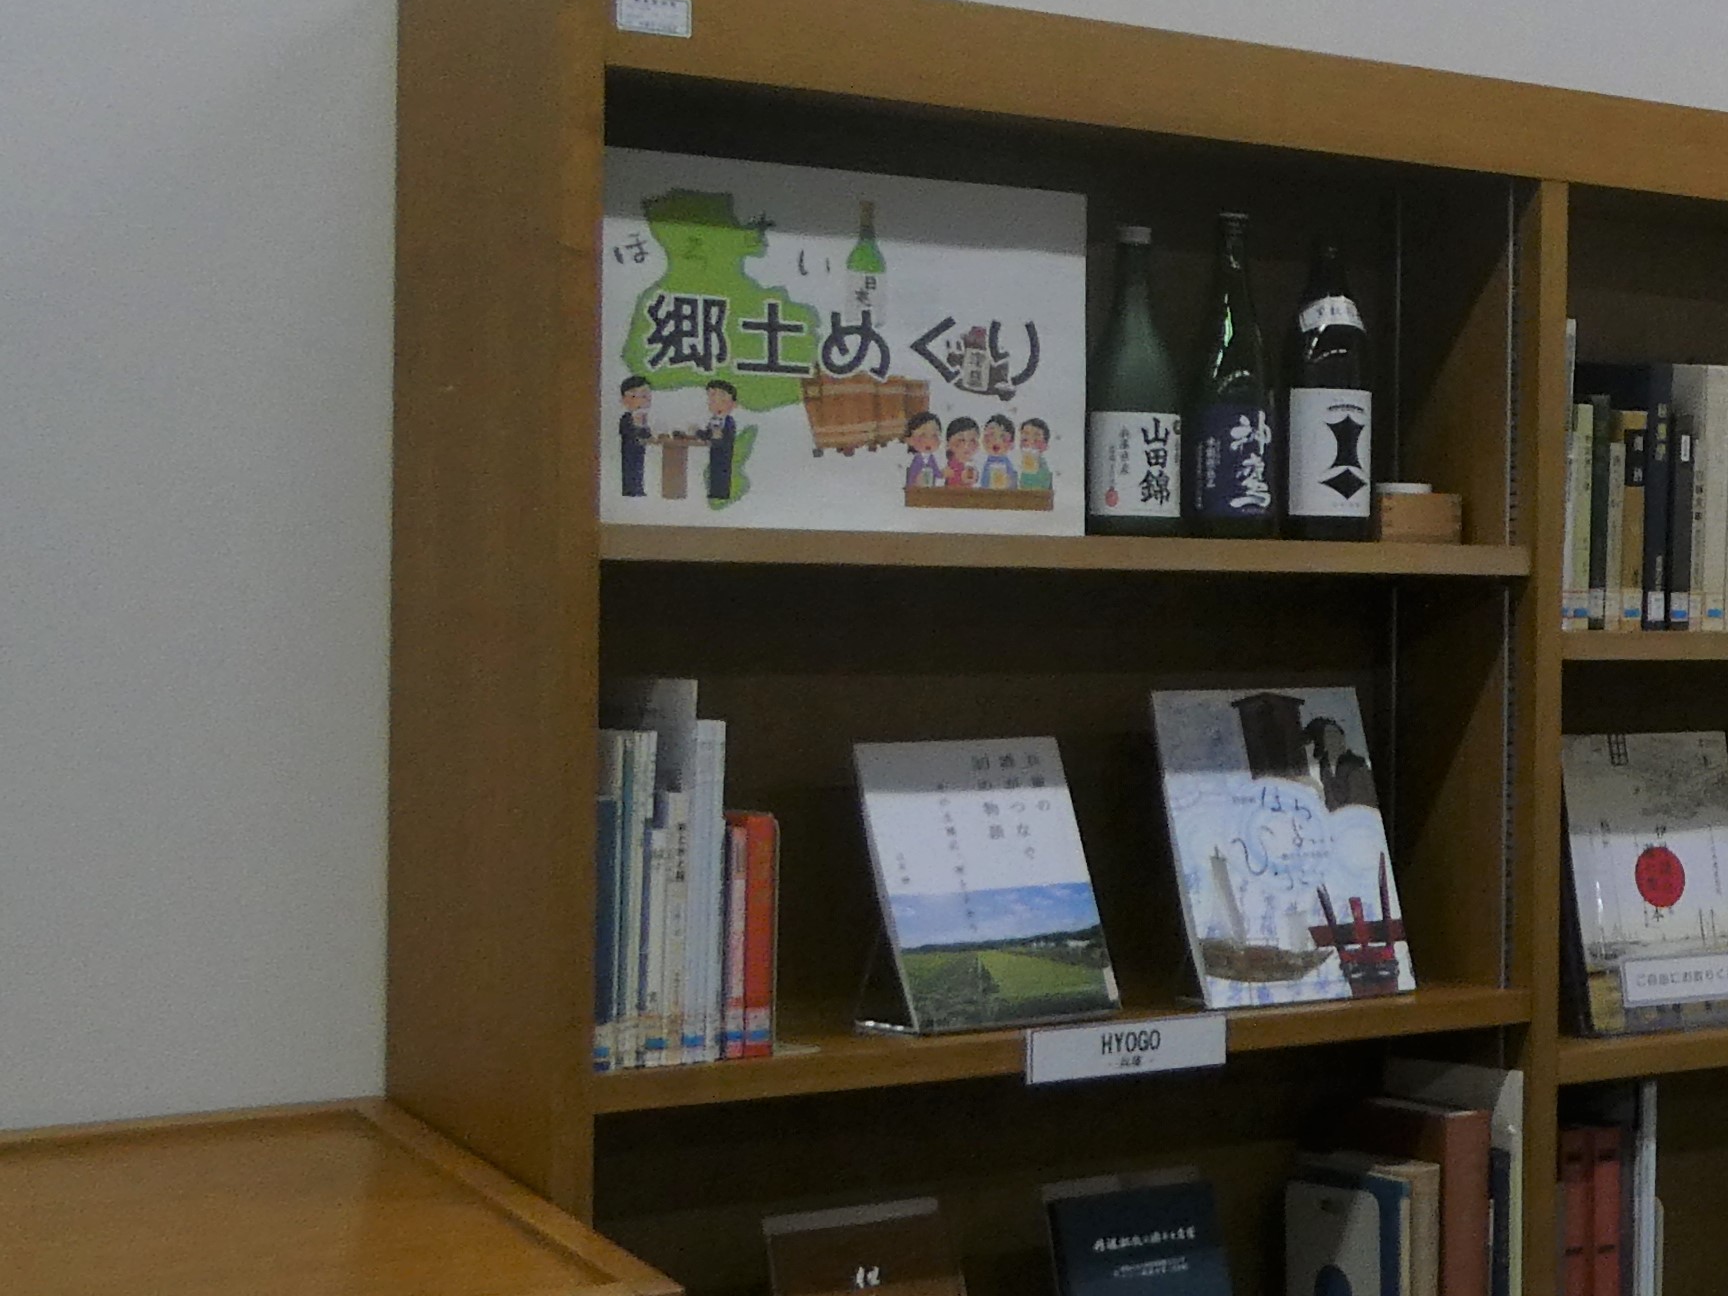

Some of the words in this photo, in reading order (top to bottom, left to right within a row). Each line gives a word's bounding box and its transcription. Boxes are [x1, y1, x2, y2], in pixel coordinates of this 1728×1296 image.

[646, 292, 1042, 386] 郷土めぐり
[1140, 417, 1172, 506] 山田錦
[1101, 1029, 1161, 1055] HYOGO
